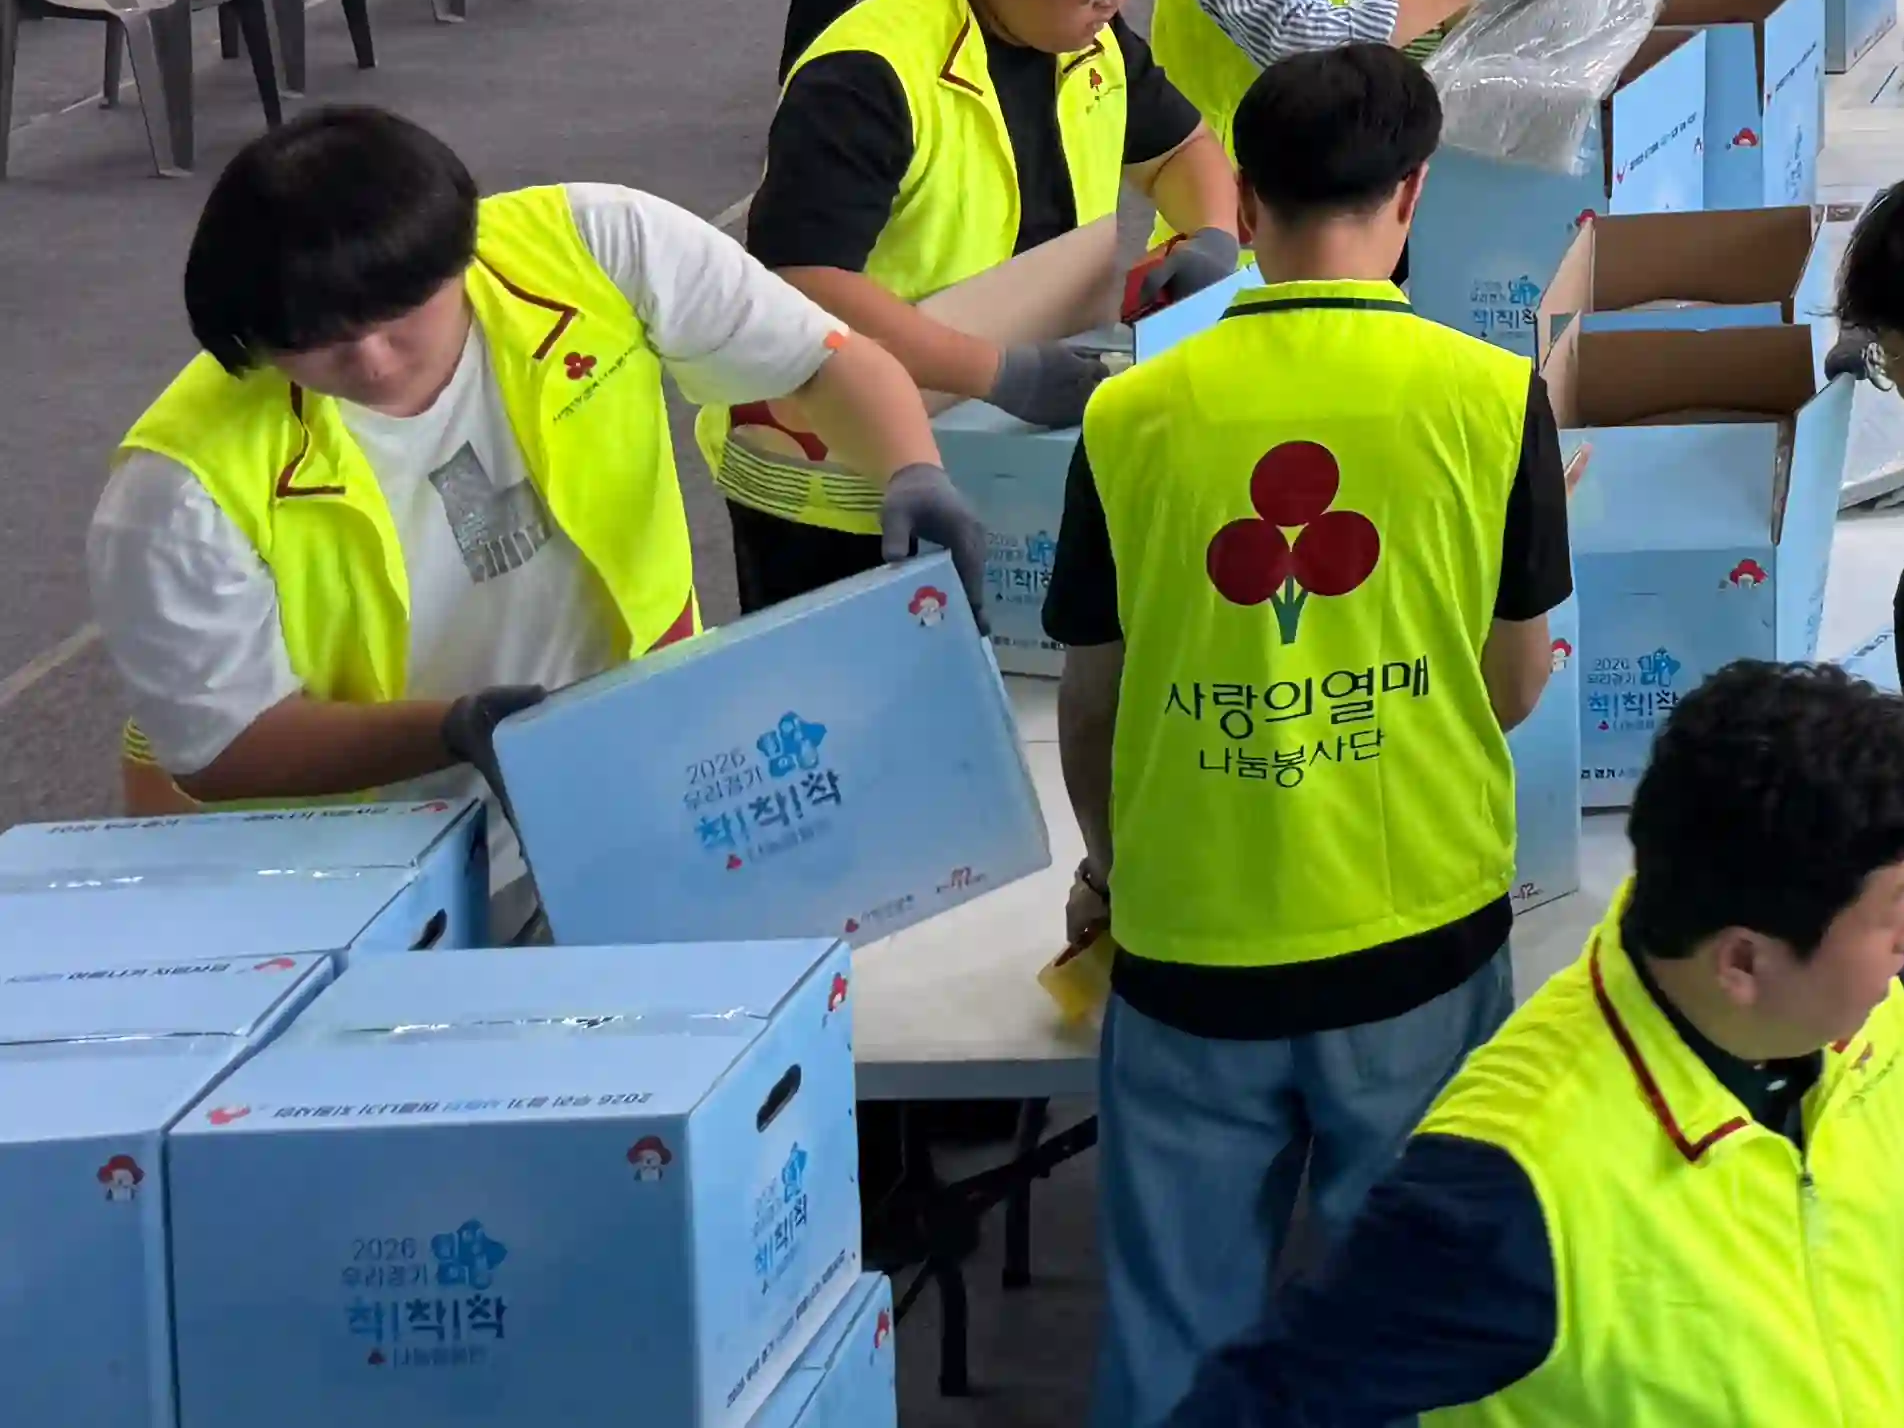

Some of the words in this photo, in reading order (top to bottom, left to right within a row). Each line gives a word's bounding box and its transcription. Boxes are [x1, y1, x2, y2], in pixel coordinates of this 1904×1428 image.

[1163, 654, 1430, 741] 사랑의열매
[686, 747, 747, 785] 2026
[1199, 727, 1386, 789] 나눔봉사단
[352, 1236, 418, 1262] 2026
